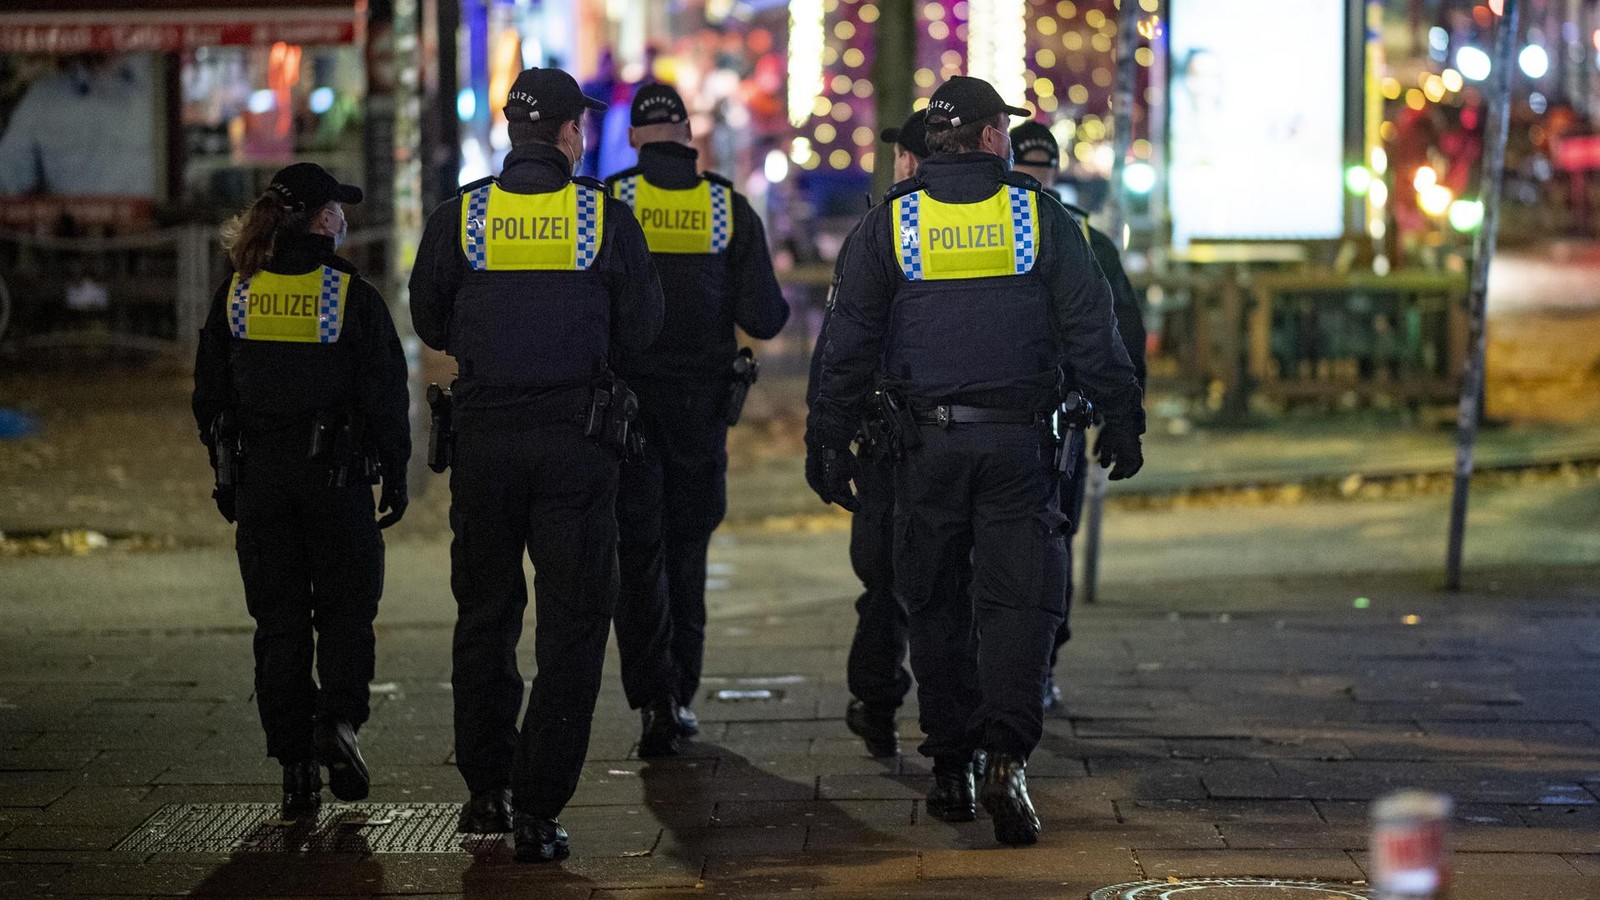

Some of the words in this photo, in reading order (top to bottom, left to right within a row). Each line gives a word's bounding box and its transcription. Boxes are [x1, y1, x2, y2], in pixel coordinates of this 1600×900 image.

[491, 217, 570, 240] POLIZEI
[641, 208, 706, 230] POLIZEI
[929, 223, 1005, 250] POLIZEI
[248, 293, 320, 317] POLIZEI
